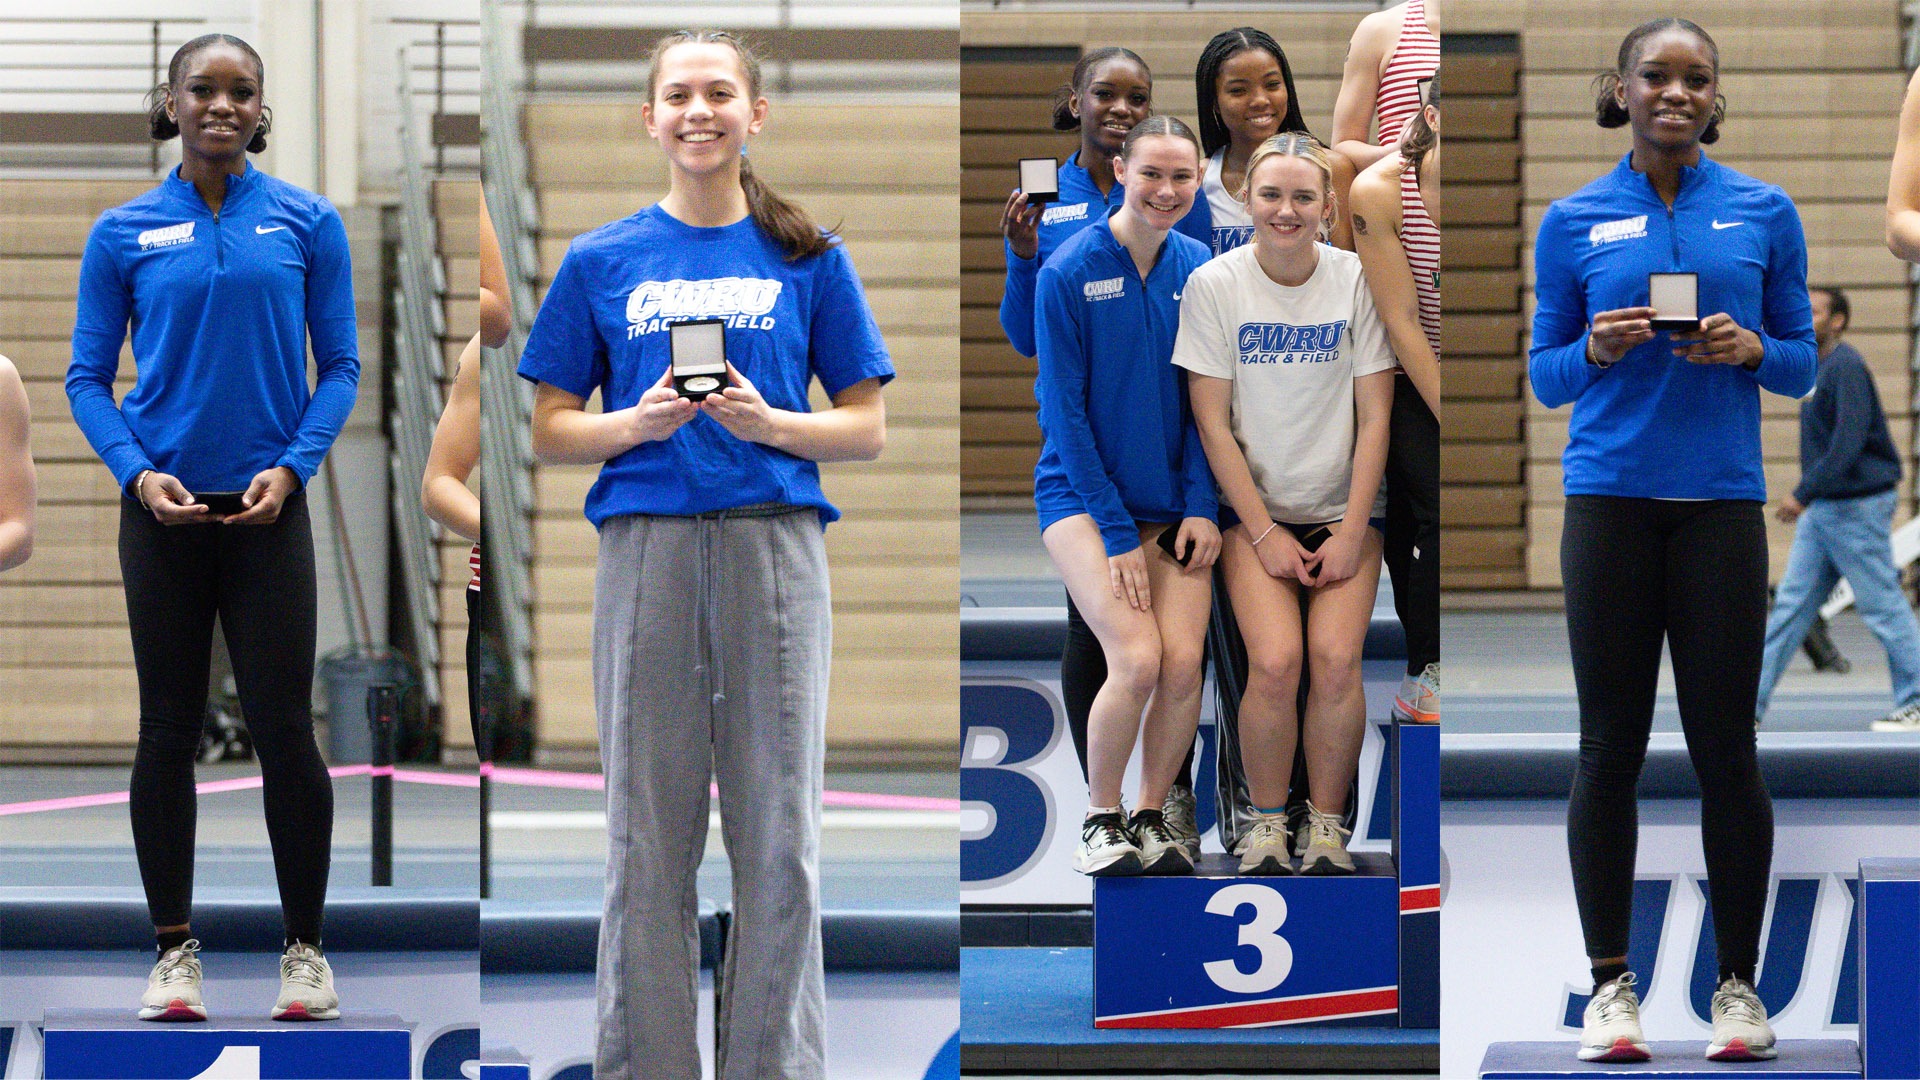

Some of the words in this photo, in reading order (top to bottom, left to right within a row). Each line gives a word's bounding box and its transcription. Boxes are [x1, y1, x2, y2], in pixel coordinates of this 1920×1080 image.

[1042, 202, 1088, 221] CWRU
[138, 221, 195, 246] CWRU
[1084, 276, 1124, 296] CWRU
[626, 276, 783, 323] CWRU
[626, 316, 689, 341] TRAC
[1238, 320, 1347, 354] CWRU
[1283, 353, 1294, 363] &
[1300, 350, 1339, 363] FIELD
[1203, 883, 1293, 993] 3
